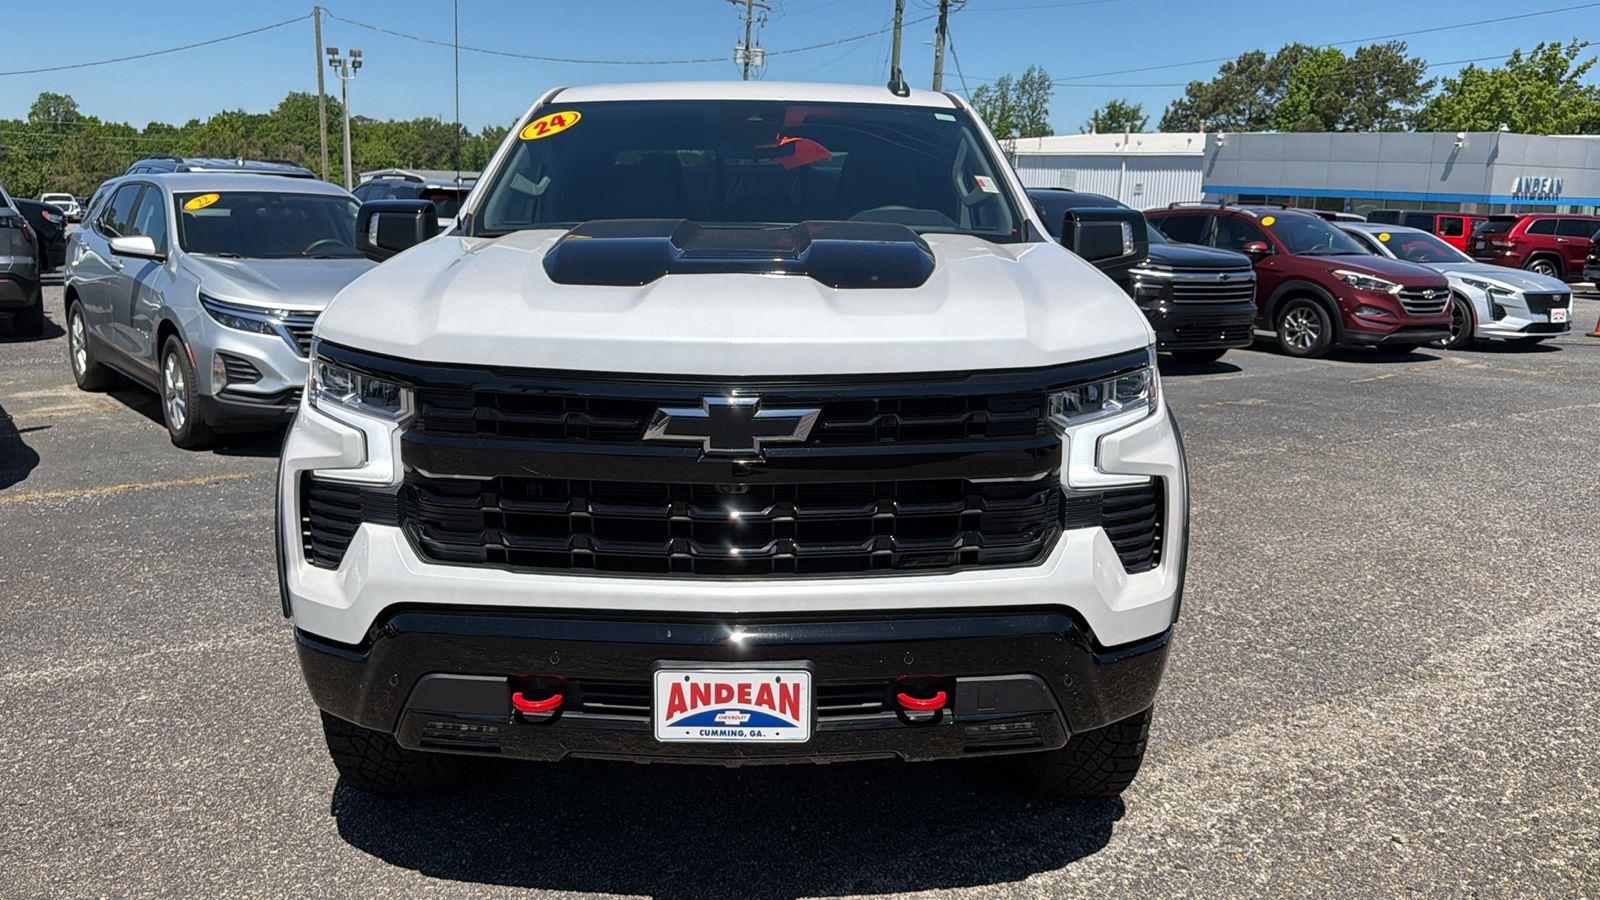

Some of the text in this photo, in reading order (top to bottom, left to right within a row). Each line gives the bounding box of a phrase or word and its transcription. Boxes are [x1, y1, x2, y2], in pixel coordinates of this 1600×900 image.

[533, 115, 567, 136] 24
[1511, 176, 1563, 193] ANDEAN
[665, 682, 801, 723] ANDEAN
[699, 729, 767, 738] CUMMING, GA.
